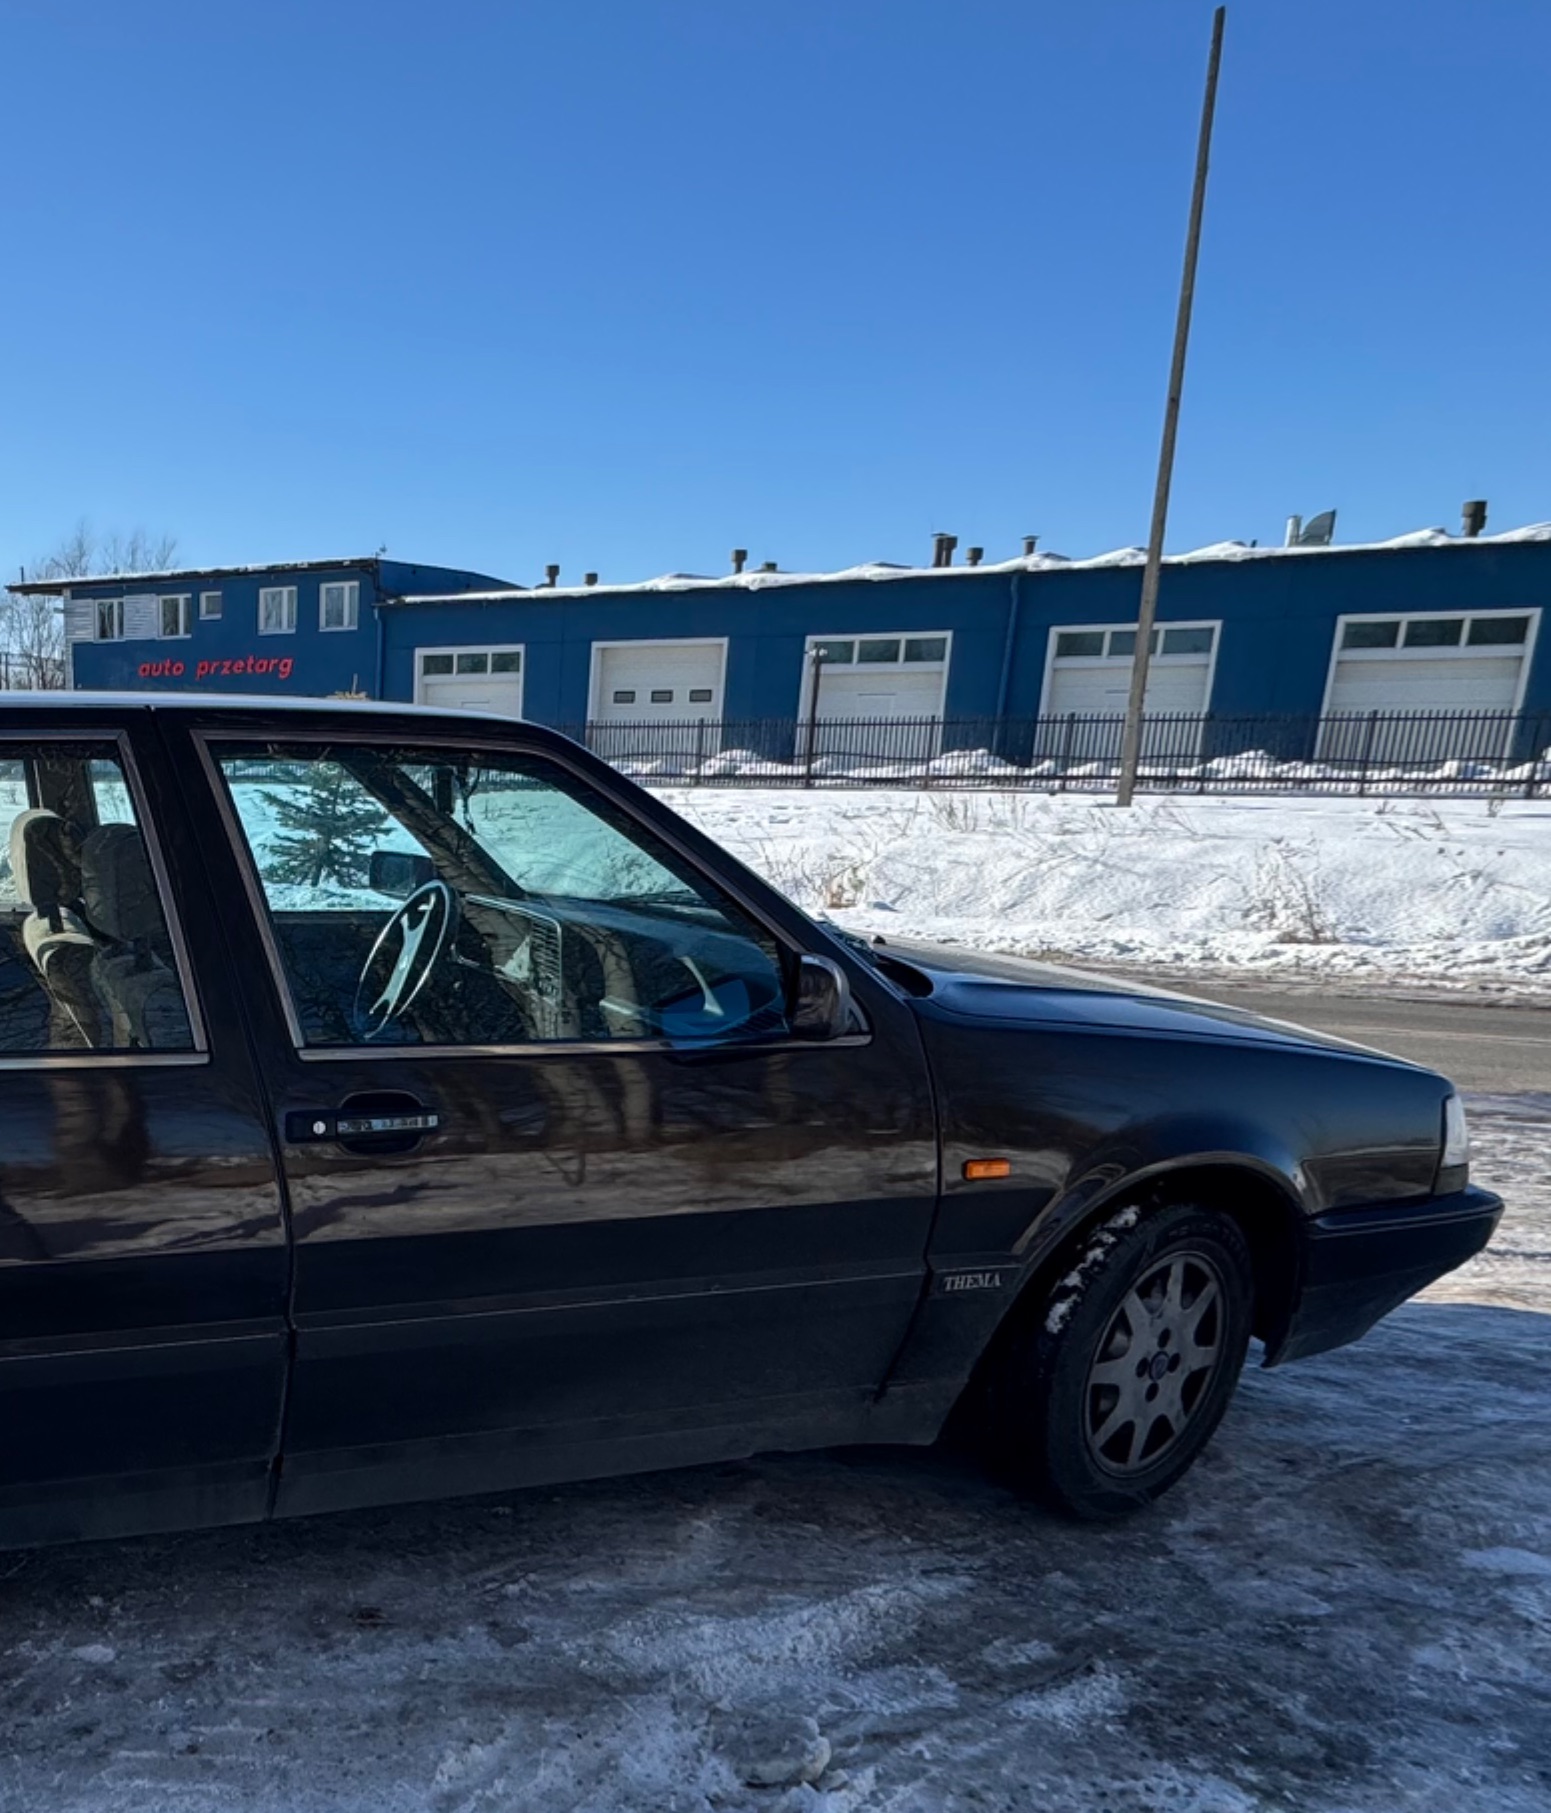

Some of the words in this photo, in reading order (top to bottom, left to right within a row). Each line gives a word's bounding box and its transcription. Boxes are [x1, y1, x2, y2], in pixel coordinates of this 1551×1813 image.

[138, 658, 184, 677] auto
[195, 655, 293, 681] przetarg
[944, 1272, 1001, 1292] THEMA
